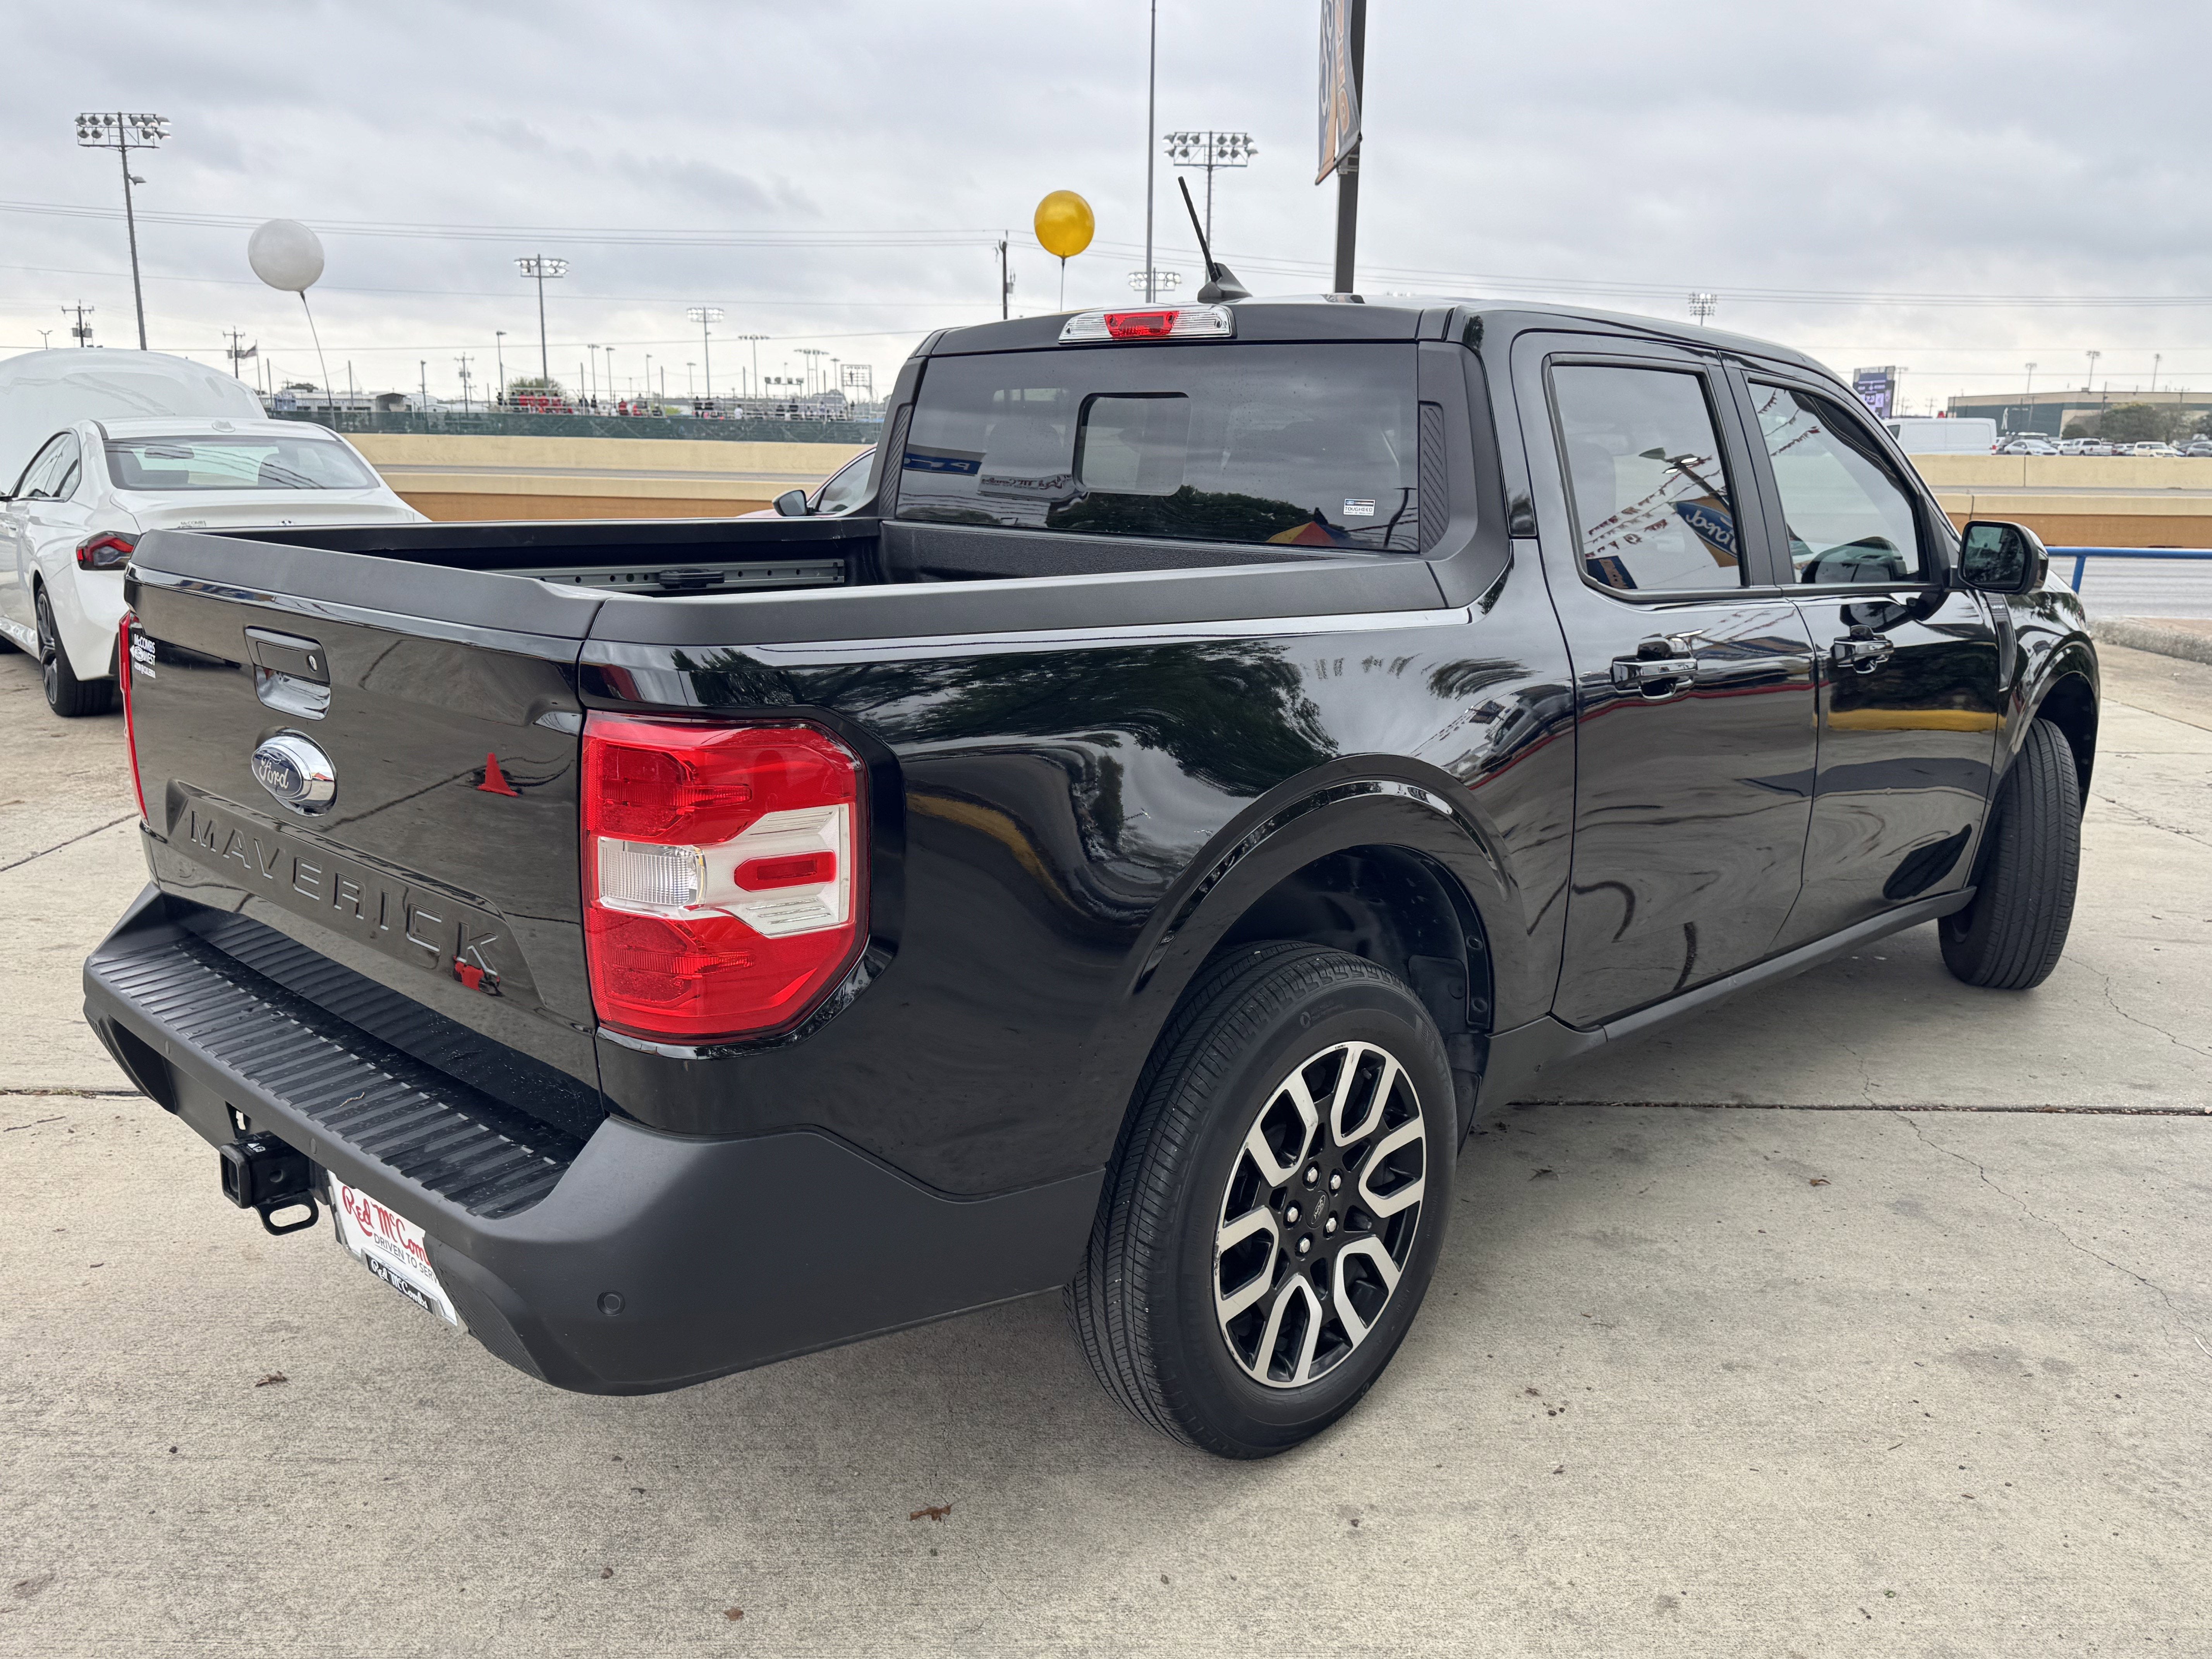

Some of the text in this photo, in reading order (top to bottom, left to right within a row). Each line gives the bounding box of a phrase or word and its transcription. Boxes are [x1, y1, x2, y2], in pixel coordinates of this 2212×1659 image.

[259, 753, 289, 789] Ford
[191, 810, 498, 976] MAVERICK
[342, 1185, 431, 1266] Red McCom
[374, 1233, 438, 1283] DRIVEN TO SERV
[371, 1259, 428, 1309] Red McCombs
